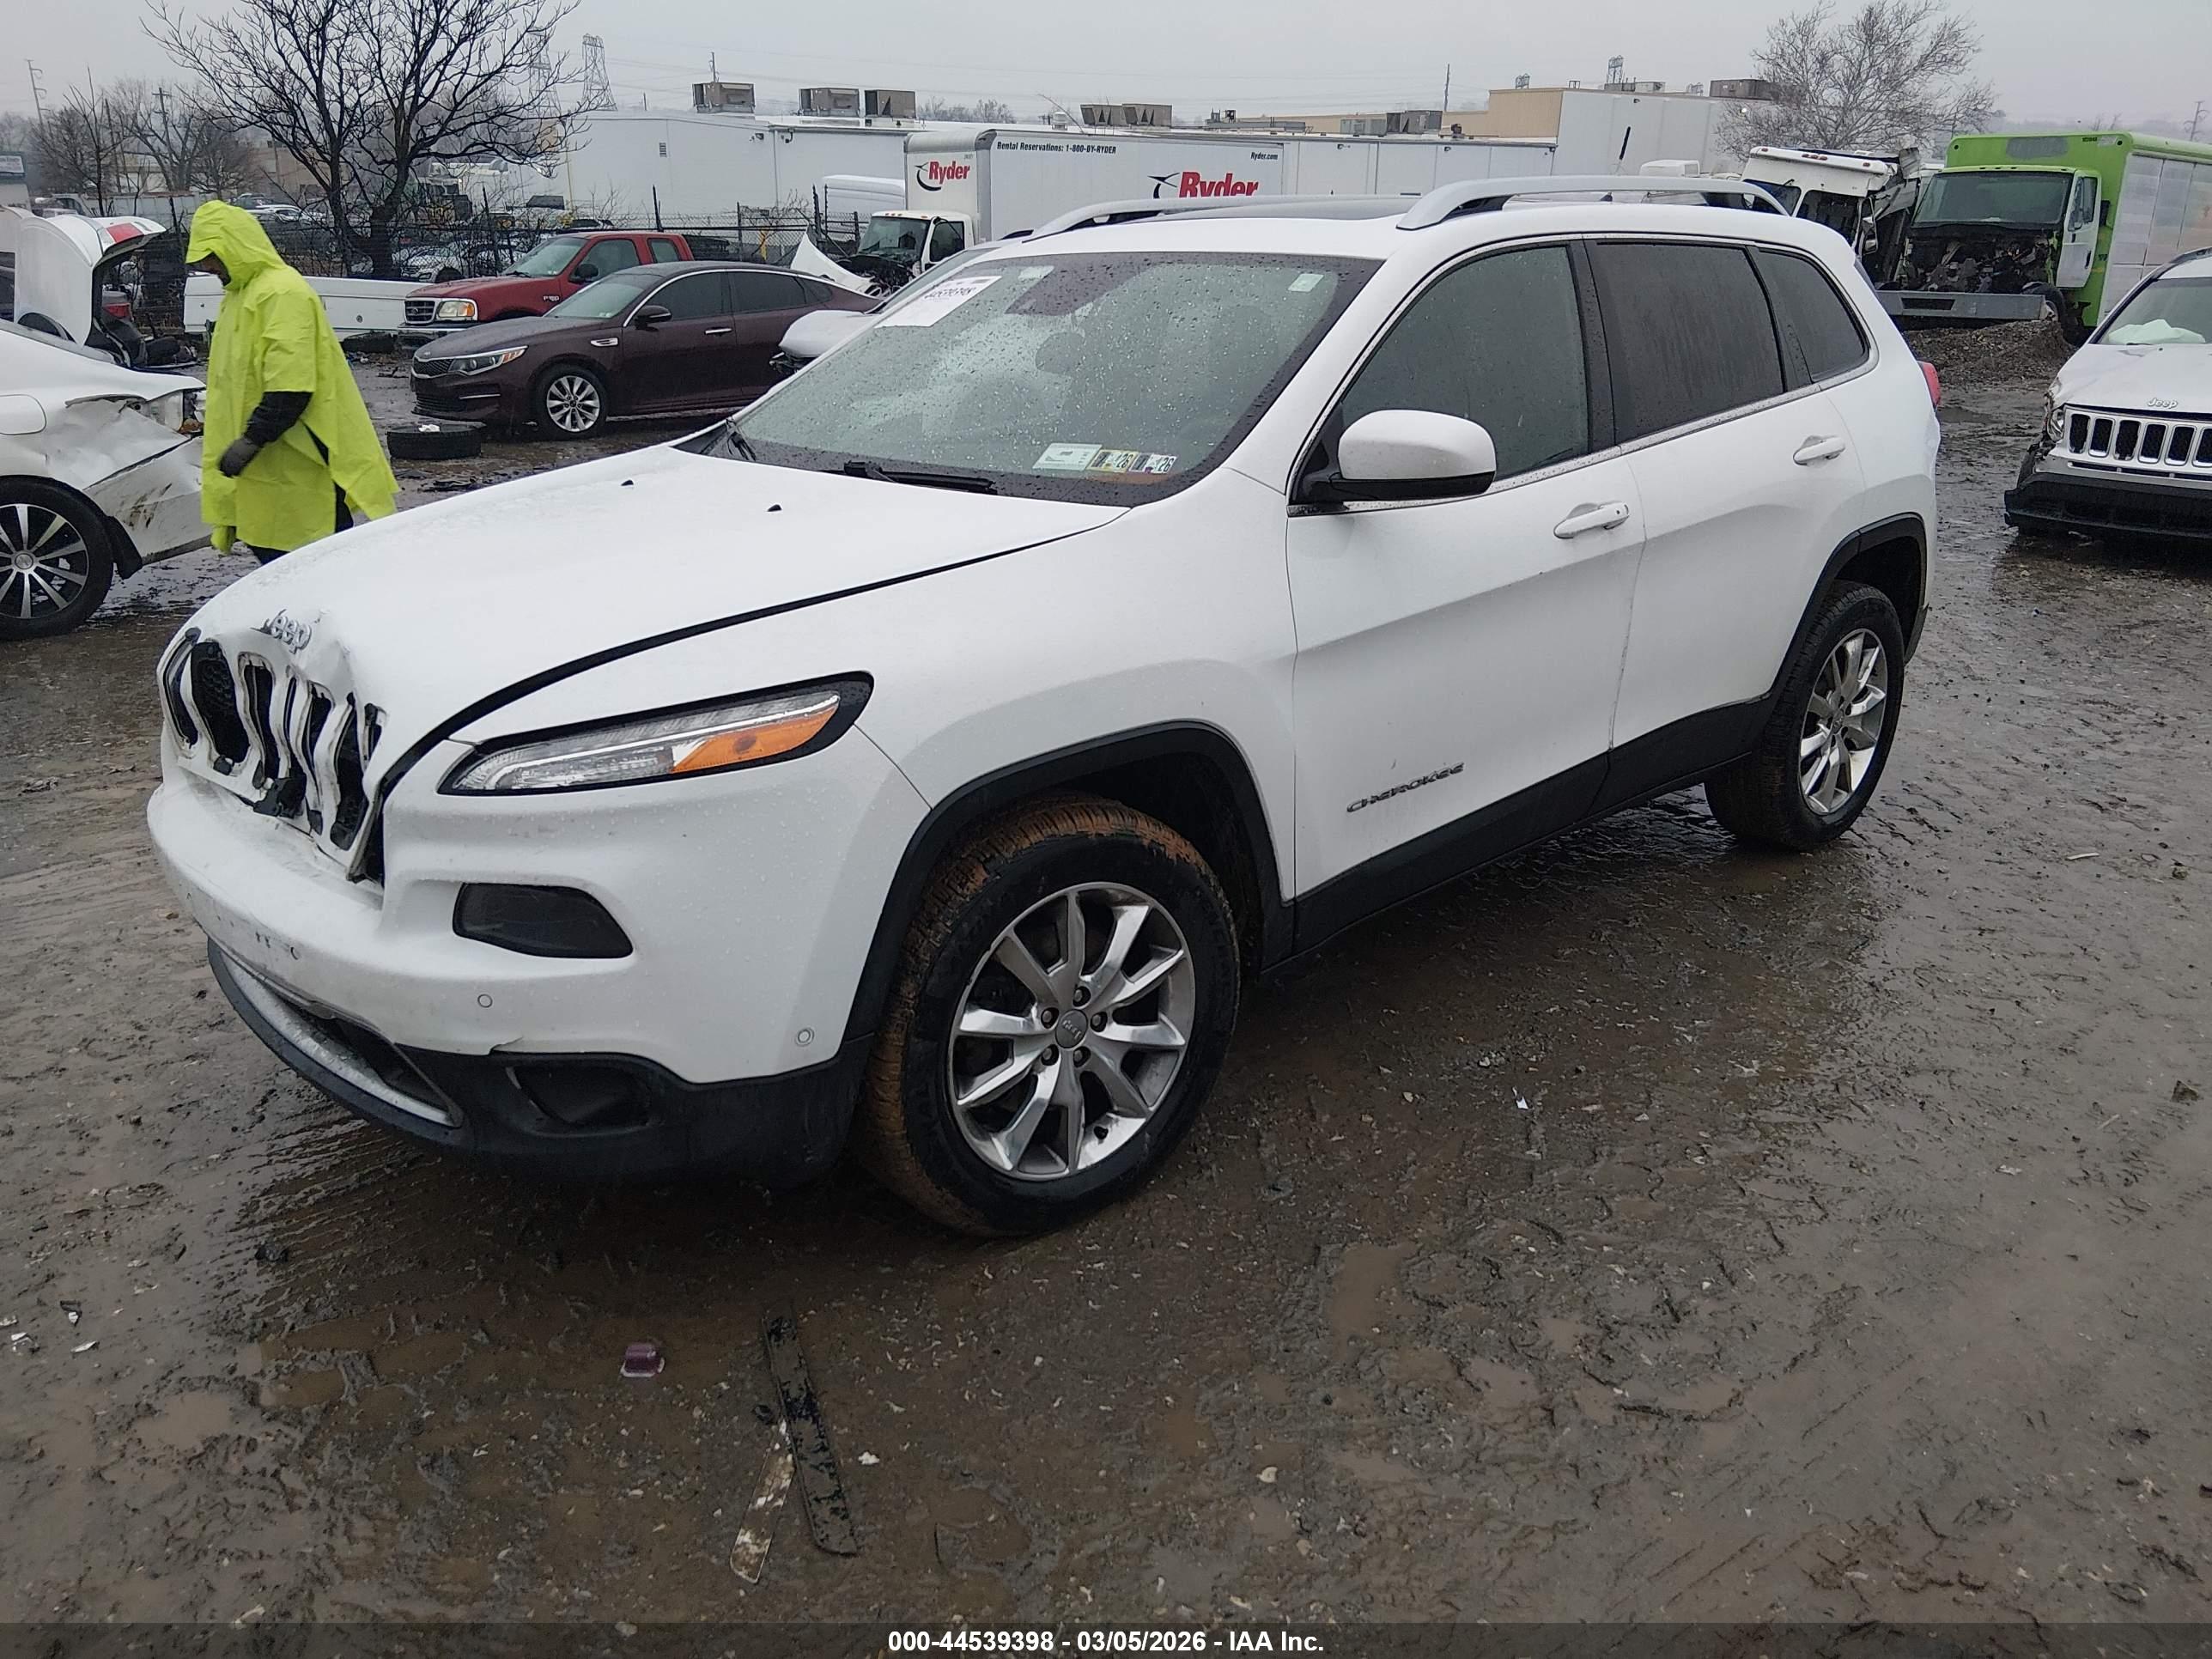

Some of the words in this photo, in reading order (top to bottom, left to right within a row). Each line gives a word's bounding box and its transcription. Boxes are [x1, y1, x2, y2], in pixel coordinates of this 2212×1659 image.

[996, 141, 1018, 150] Rental
[1019, 143, 1064, 153] Reservations:
[1066, 144, 1116, 155] 1-800-BY-RYDER
[1250, 152, 1279, 161] Ryder.com
[928, 161, 970, 185] Ryder
[2148, 397, 2179, 410] Jeep
